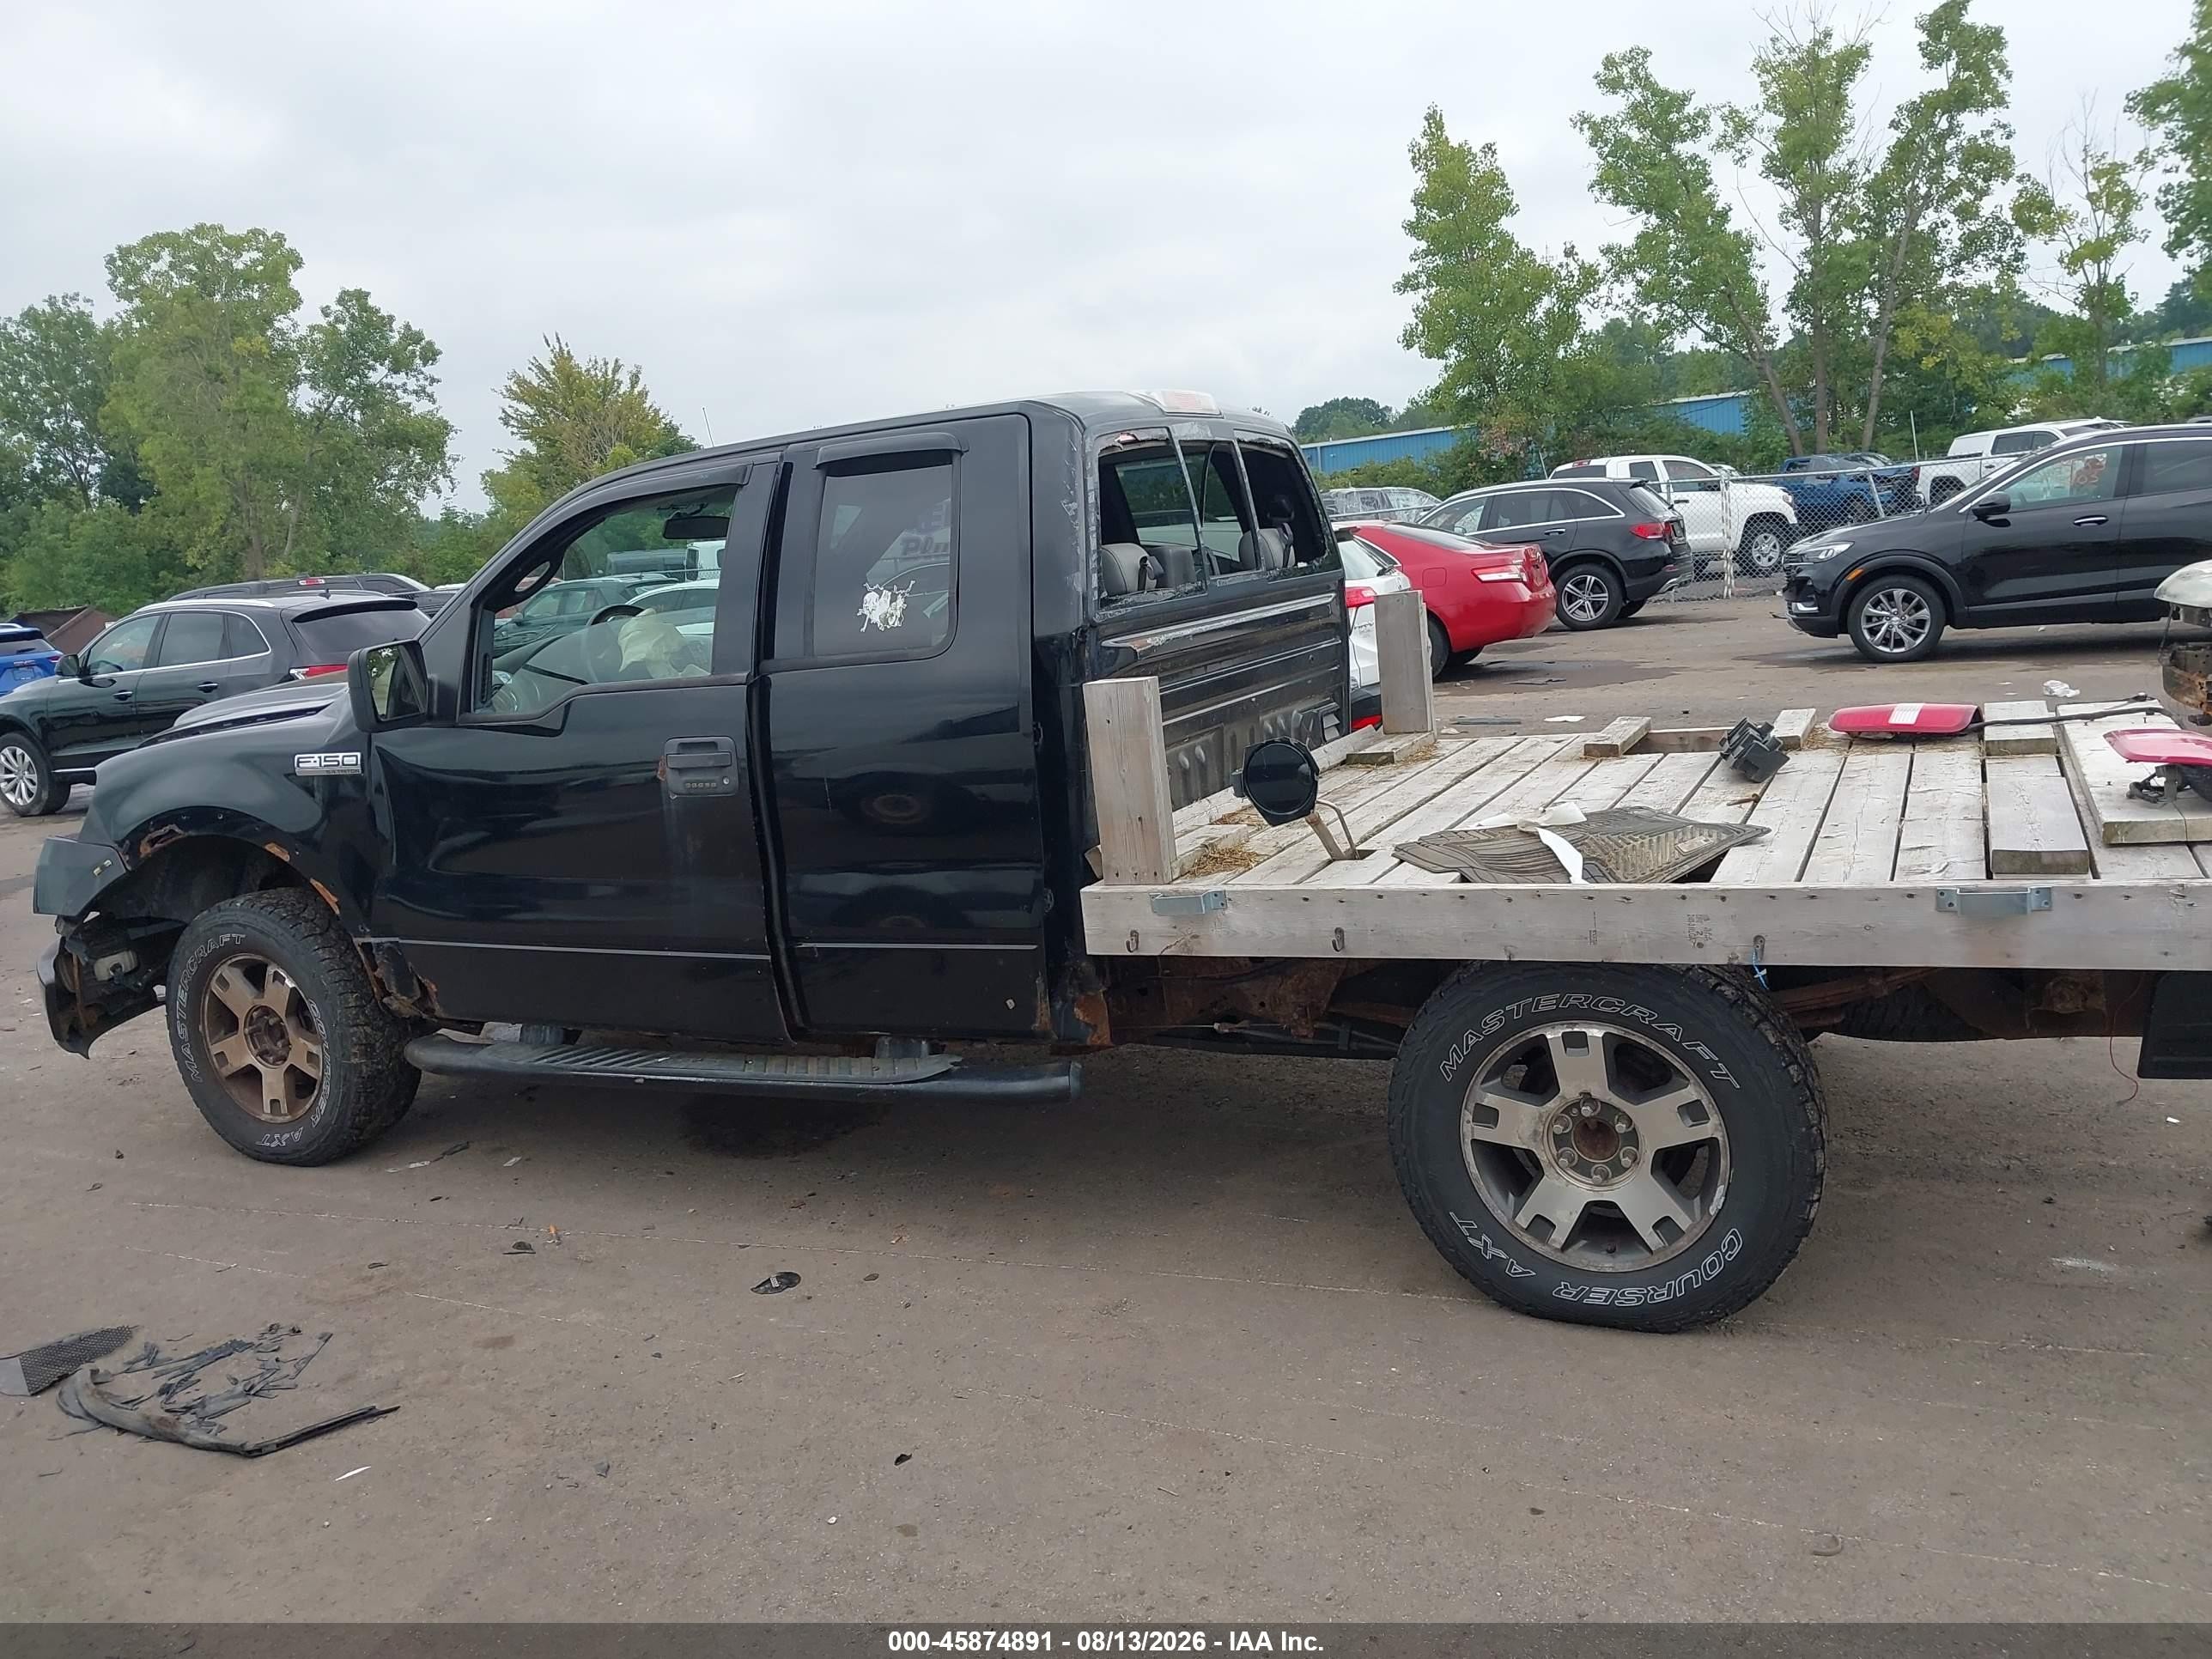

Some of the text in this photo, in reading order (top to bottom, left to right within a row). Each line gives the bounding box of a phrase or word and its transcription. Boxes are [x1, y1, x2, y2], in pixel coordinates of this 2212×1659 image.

[296, 754, 359, 768] F-150
[175, 933, 246, 1083] MASTERCRAFT
[1439, 993, 1741, 1090] MASTERCRAFT
[256, 999, 332, 1148] COURSER AXT
[1450, 1212, 1744, 1308] COURSER AXT
